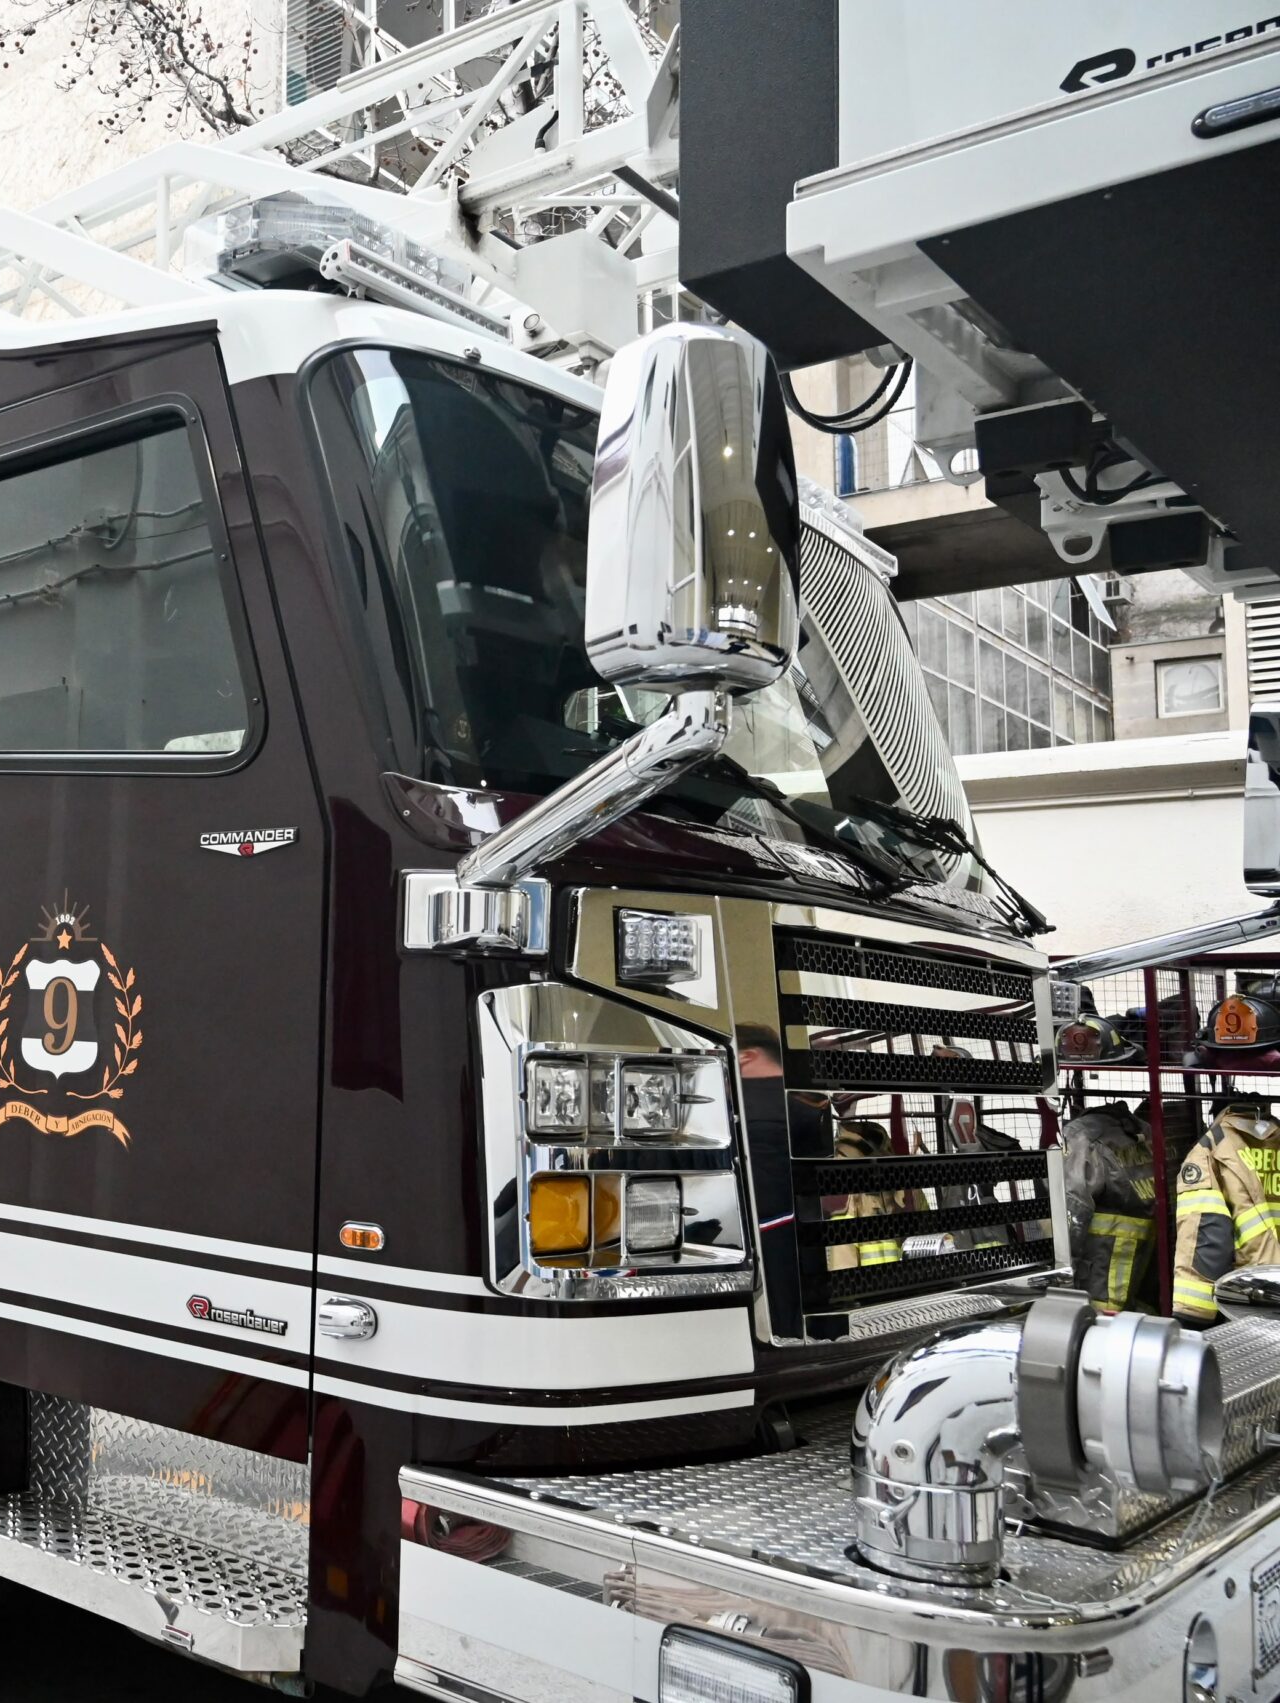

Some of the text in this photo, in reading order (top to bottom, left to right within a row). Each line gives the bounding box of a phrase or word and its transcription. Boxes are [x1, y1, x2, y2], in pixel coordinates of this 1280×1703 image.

[200, 829, 294, 845] COMMANDER
[55, 913, 76, 926] 1892
[41, 977, 78, 1055] 9
[1225, 1013, 1241, 1034] 9
[1073, 1032, 1089, 1052] 9
[11, 1104, 111, 1131] DEBER Y ABNEGACIÓN
[211, 1310, 285, 1334] rosenbauer
